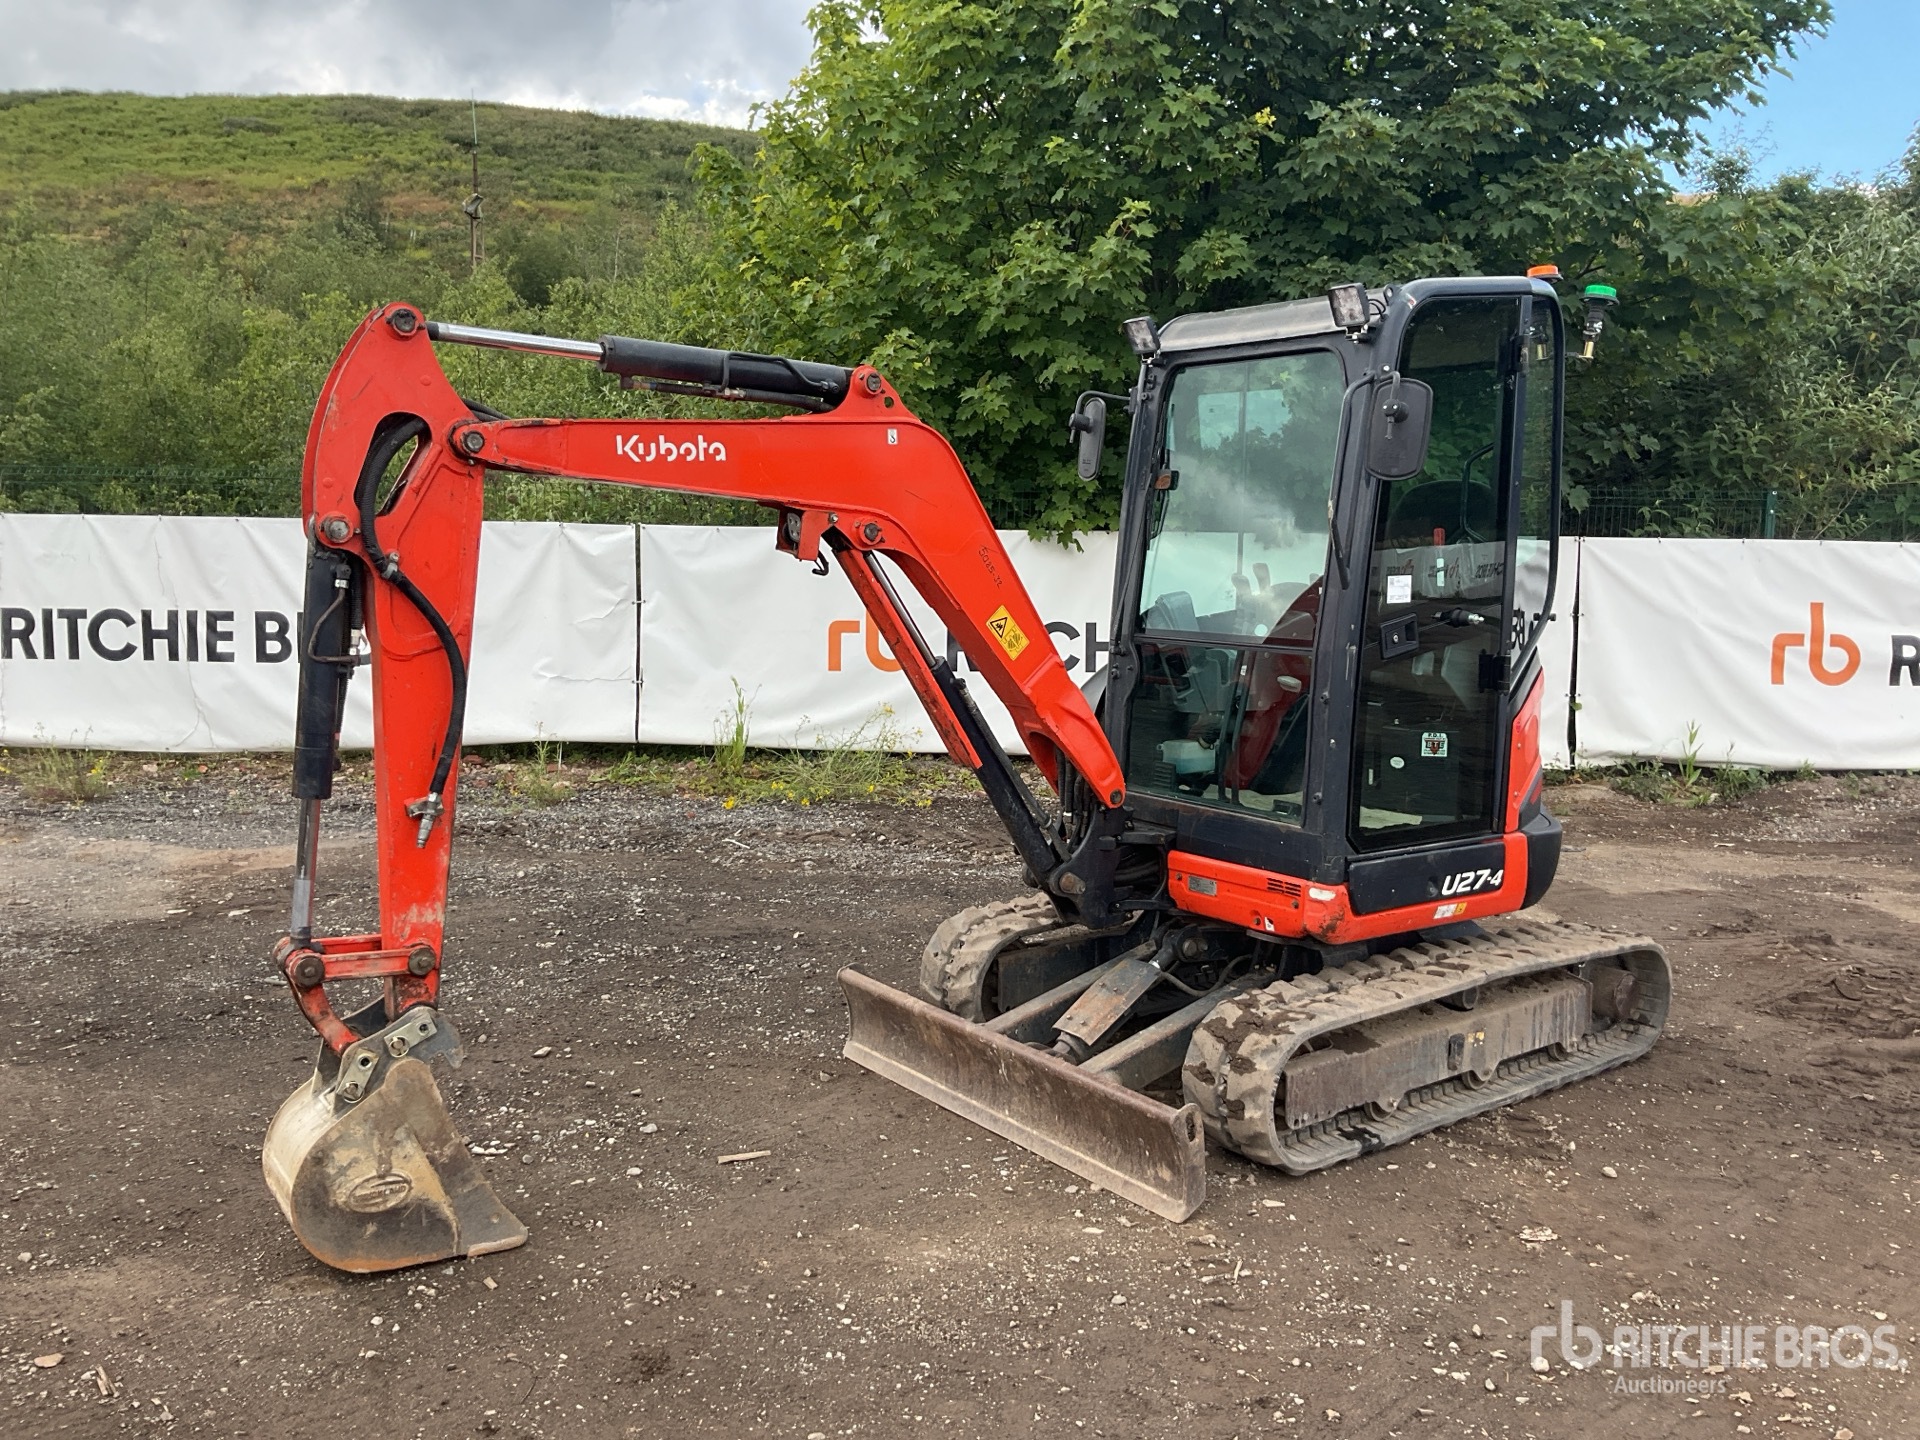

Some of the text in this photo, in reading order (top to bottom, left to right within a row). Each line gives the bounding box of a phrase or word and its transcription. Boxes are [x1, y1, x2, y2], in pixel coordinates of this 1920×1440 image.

[615, 434, 727, 463] Kubota
[1, 607, 235, 662] RITCHIE
[1771, 602, 1862, 686] rb
[1426, 741, 1445, 749] BTE
[1441, 868, 1504, 896] U27-4
